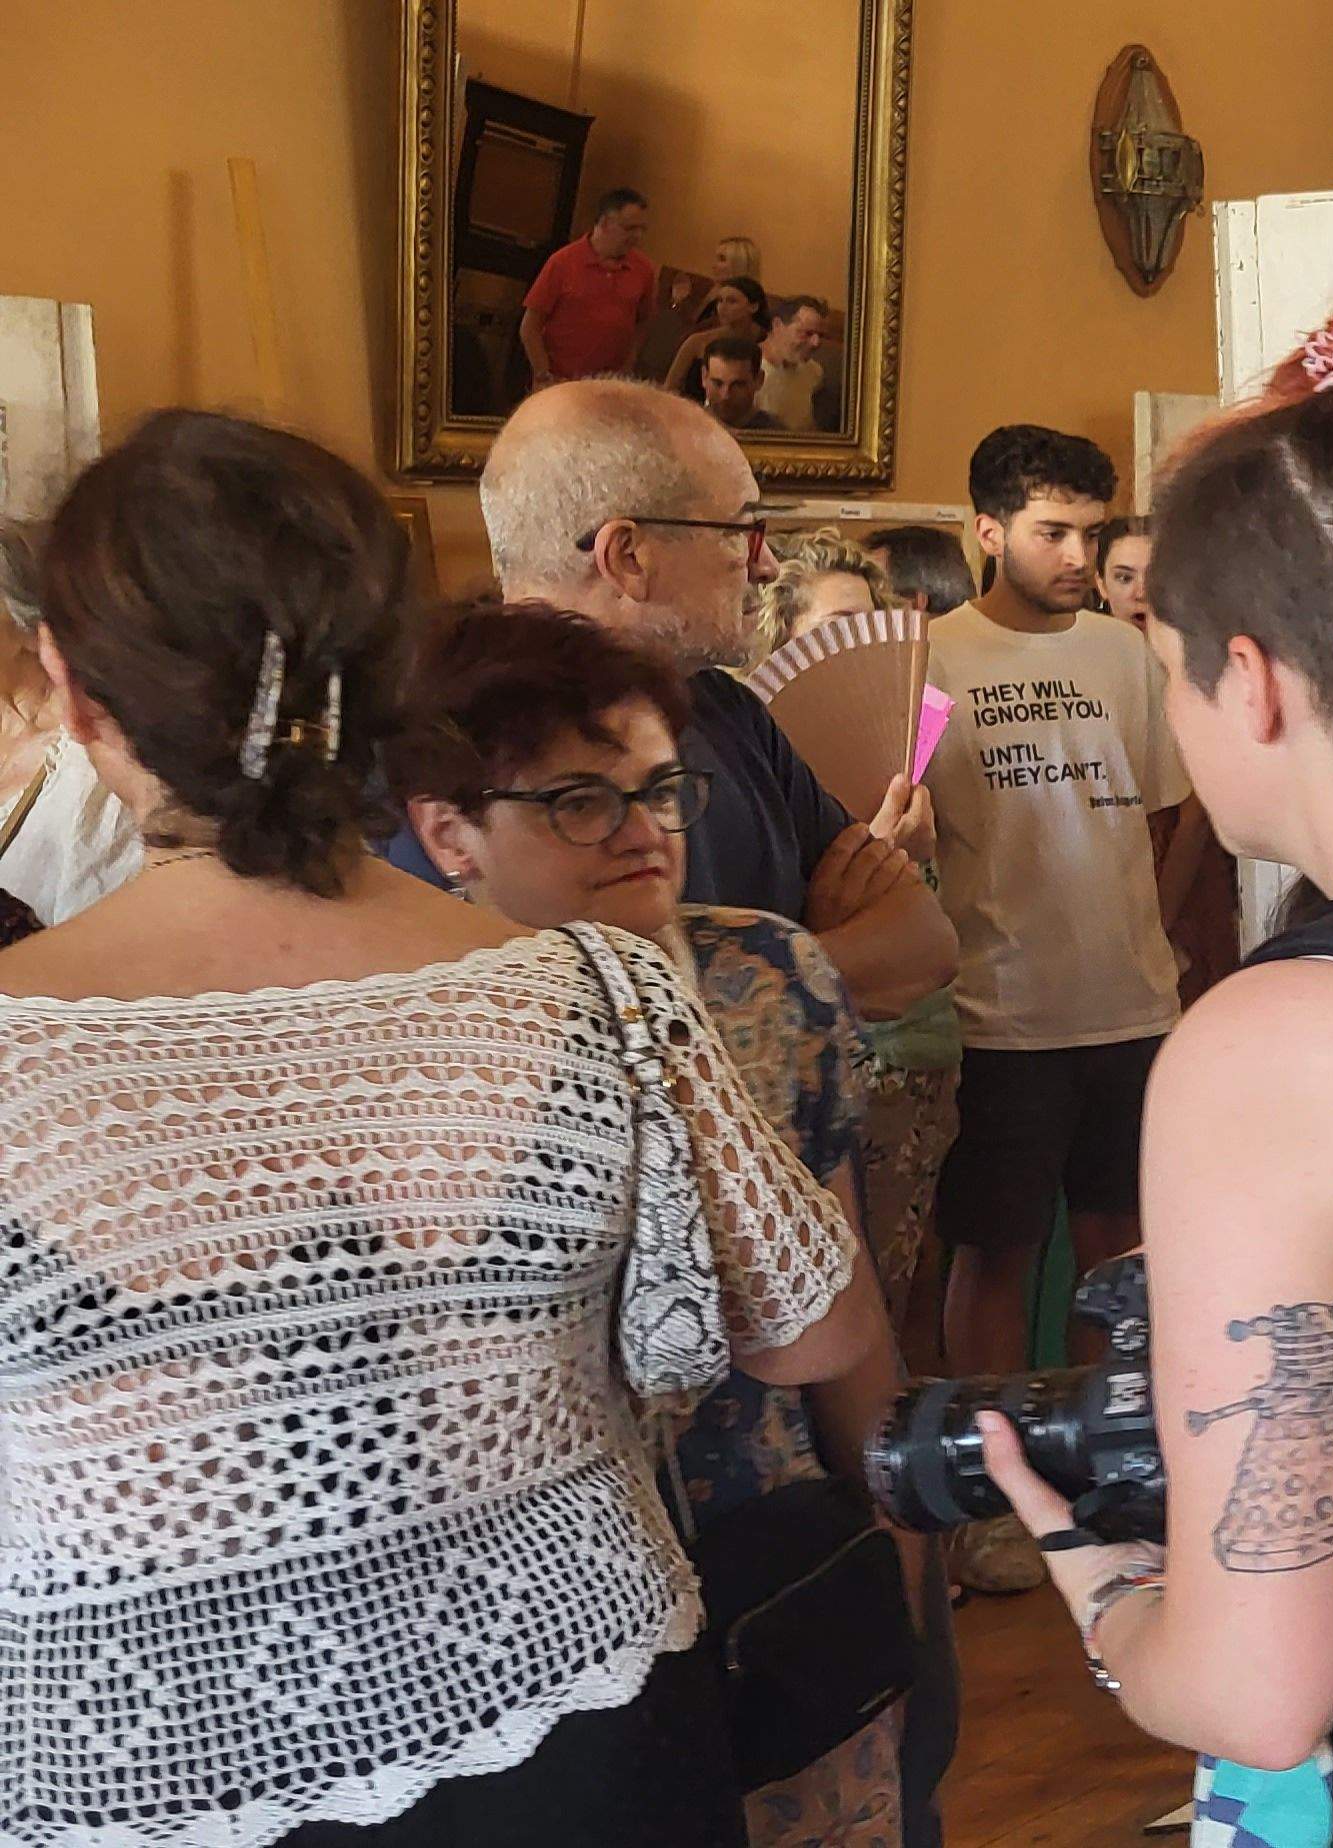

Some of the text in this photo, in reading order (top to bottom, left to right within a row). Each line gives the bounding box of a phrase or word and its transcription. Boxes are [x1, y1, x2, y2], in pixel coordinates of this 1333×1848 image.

[968, 680, 1082, 706] THEY WILL
[973, 700, 1110, 729] IGNORE YOU,
[980, 744, 1045, 768] UNTIL
[984, 761, 1107, 791] THEY CAN'T.
